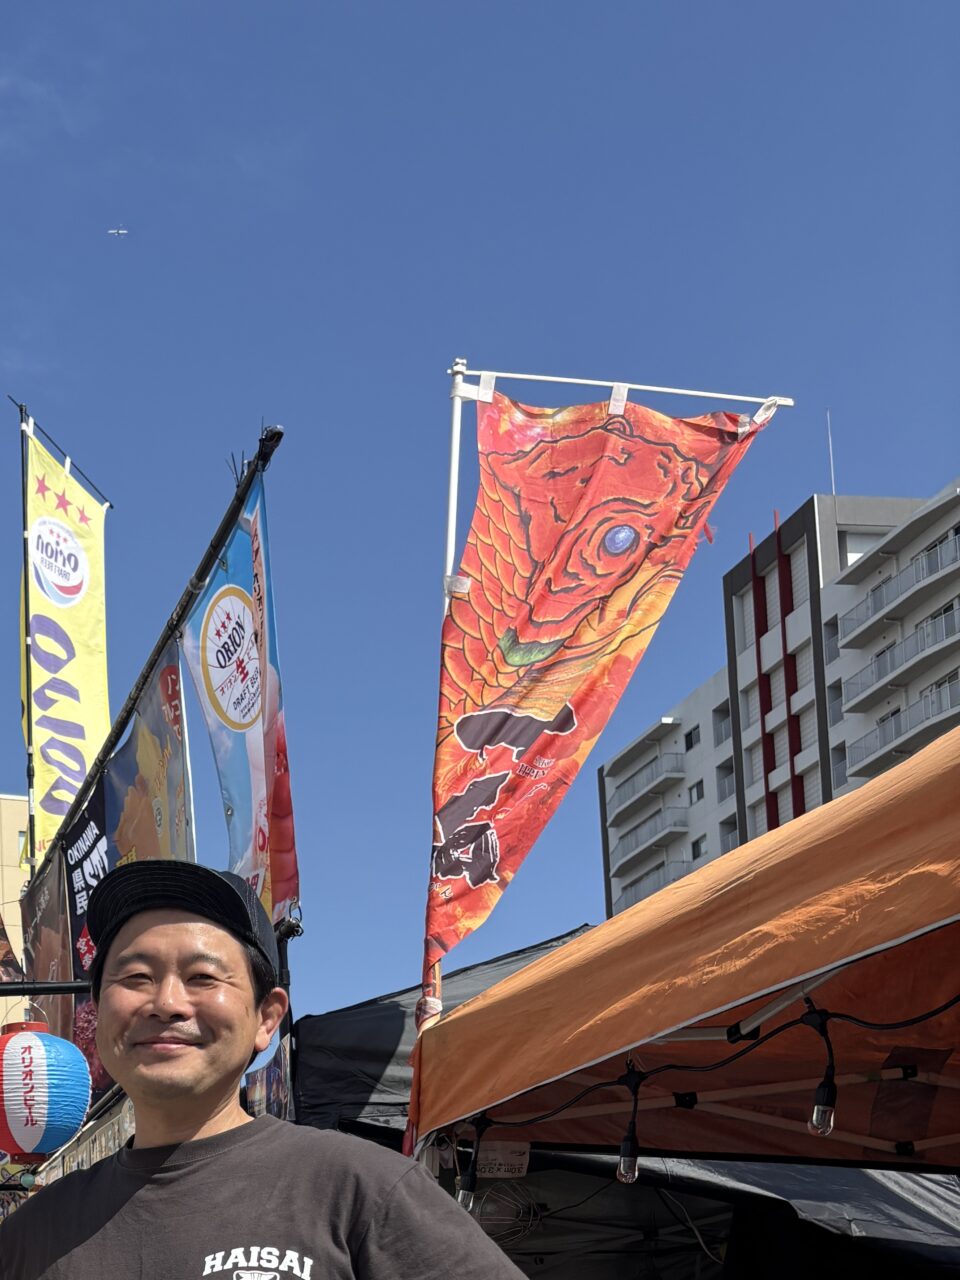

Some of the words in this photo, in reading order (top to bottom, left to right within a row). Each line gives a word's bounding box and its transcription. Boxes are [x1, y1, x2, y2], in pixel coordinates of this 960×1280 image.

[216, 615, 246, 669] ORION
[67, 821, 100, 866] OKINAWA
[20, 1045, 37, 1127] オリオンビール
